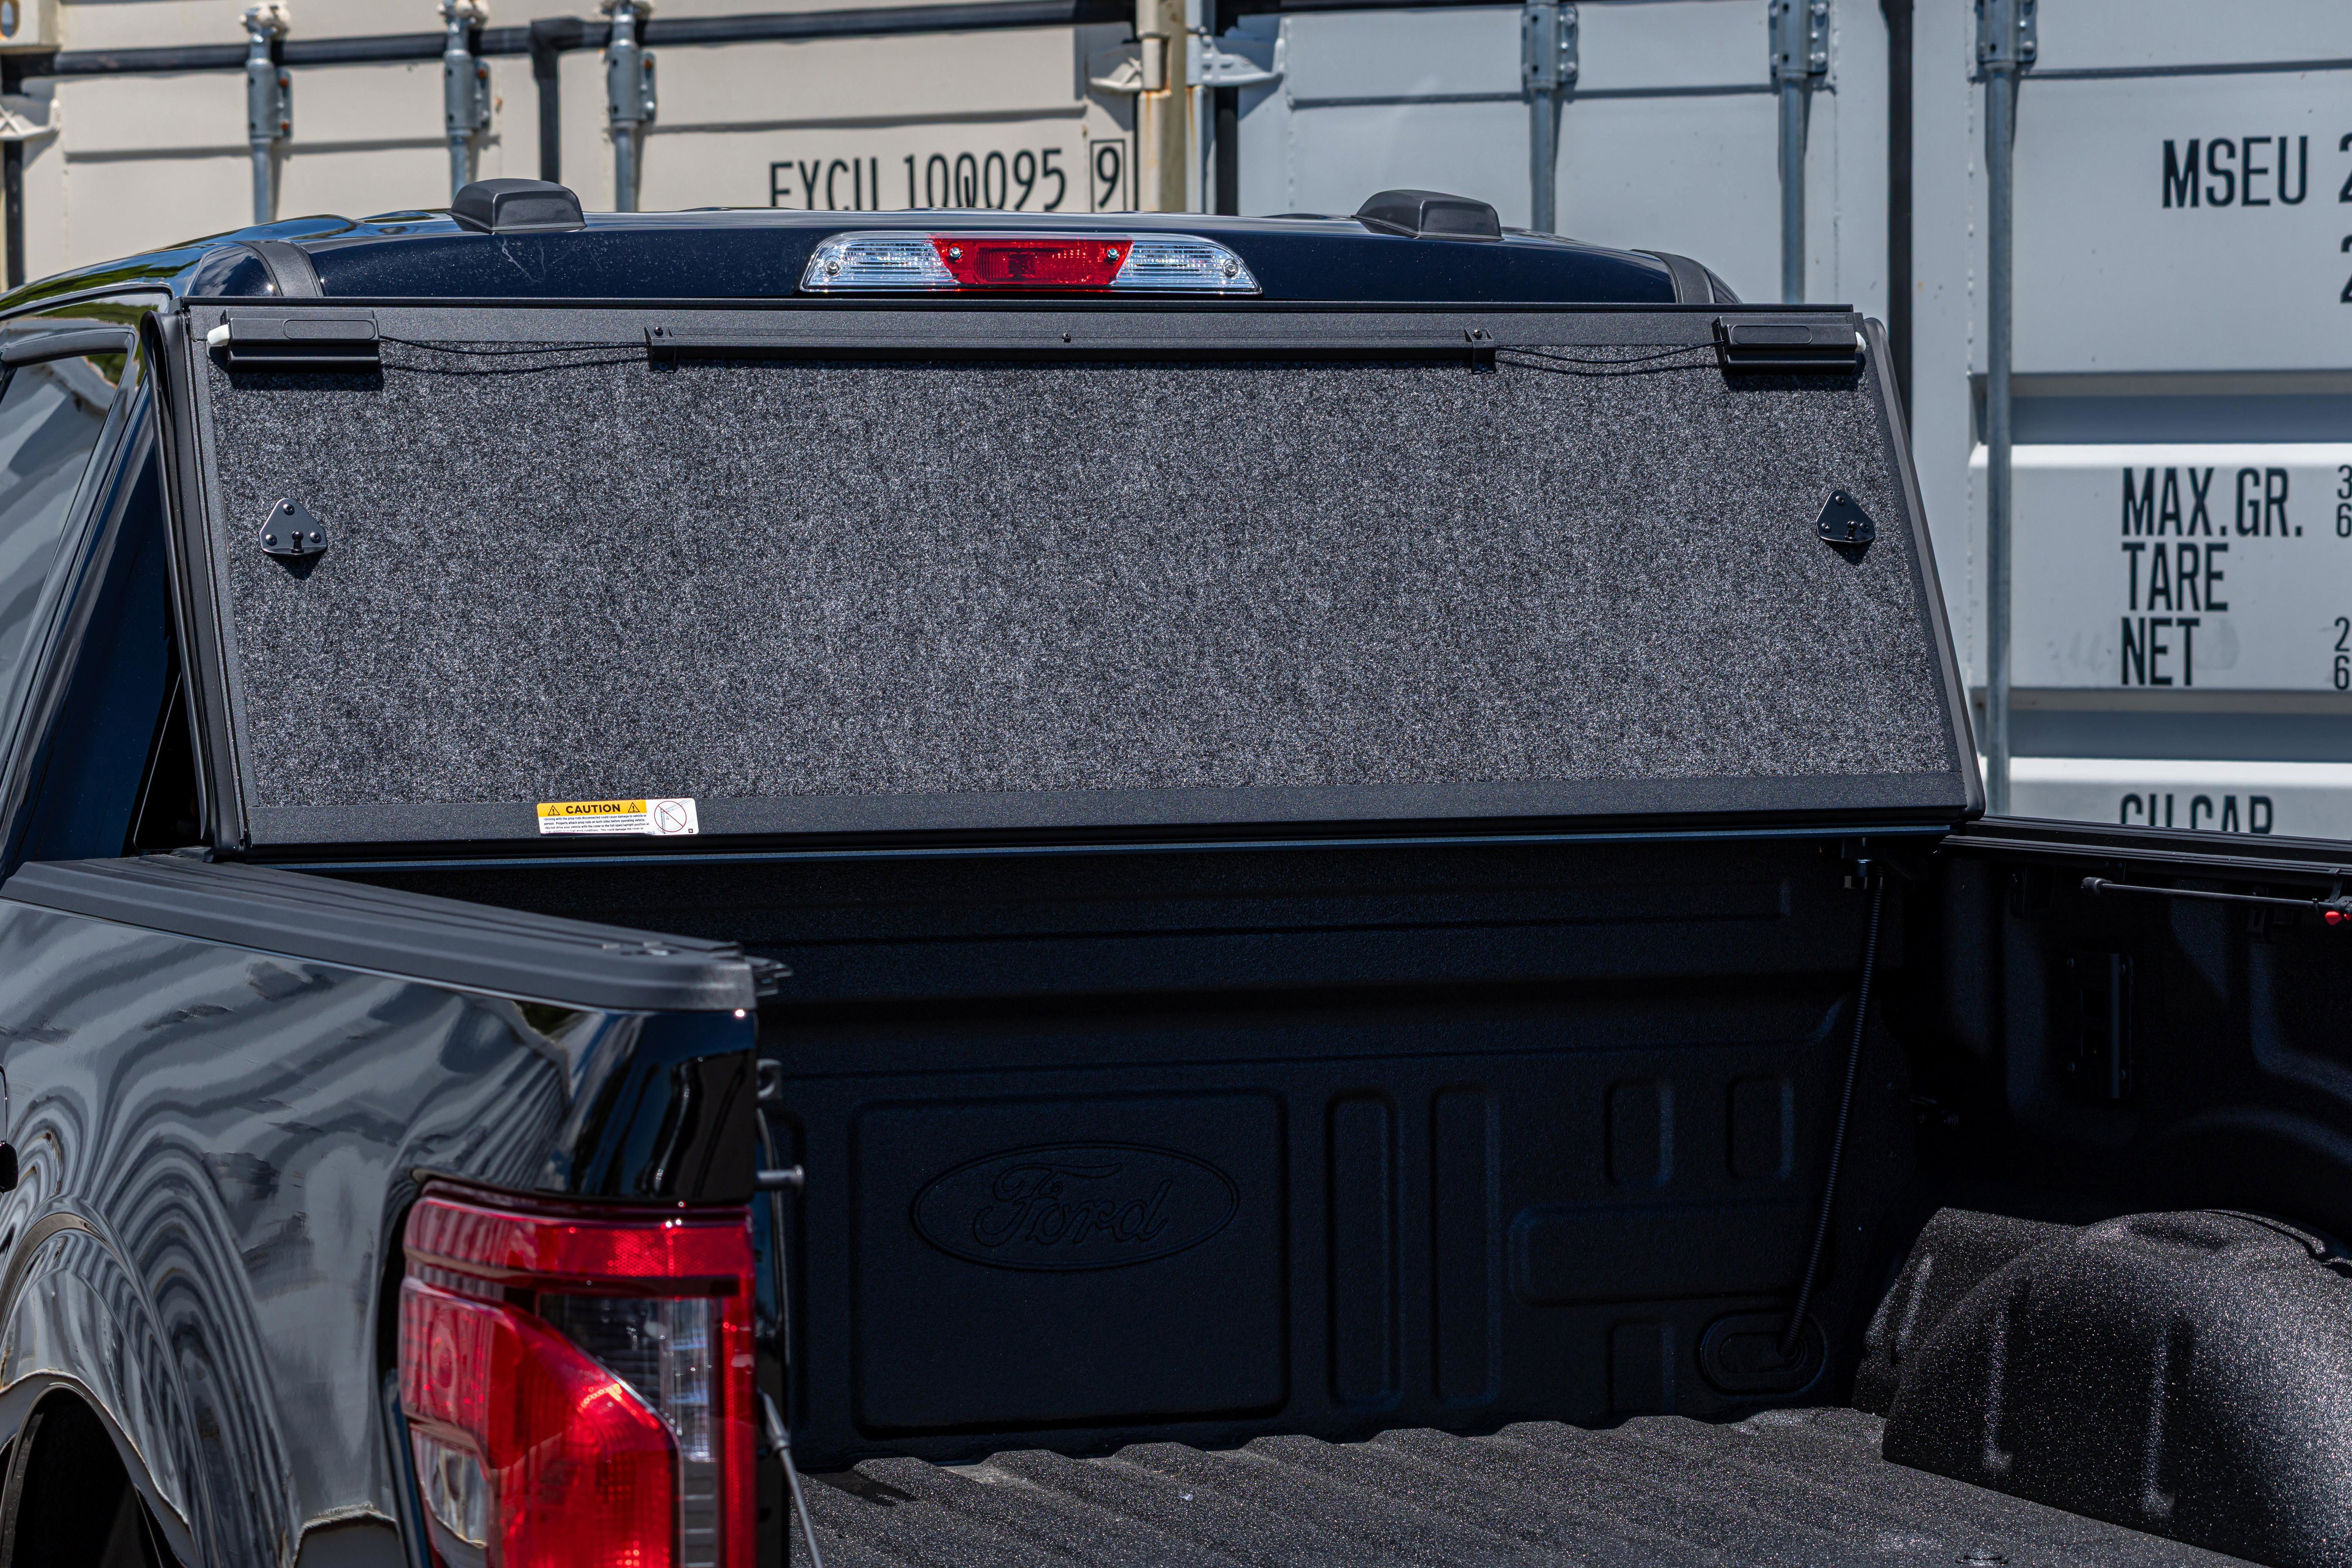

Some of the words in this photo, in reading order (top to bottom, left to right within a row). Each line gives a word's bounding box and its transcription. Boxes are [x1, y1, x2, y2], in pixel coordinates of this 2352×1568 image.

[1096, 145, 1120, 209] 9
[2162, 135, 2308, 209] MSEU
[2122, 467, 2303, 537] MAX.GR.
[2122, 542, 2229, 611] TARE
[2121, 617, 2201, 686] NET
[566, 804, 621, 814] CAUTION
[973, 1163, 1173, 1247] Ford
